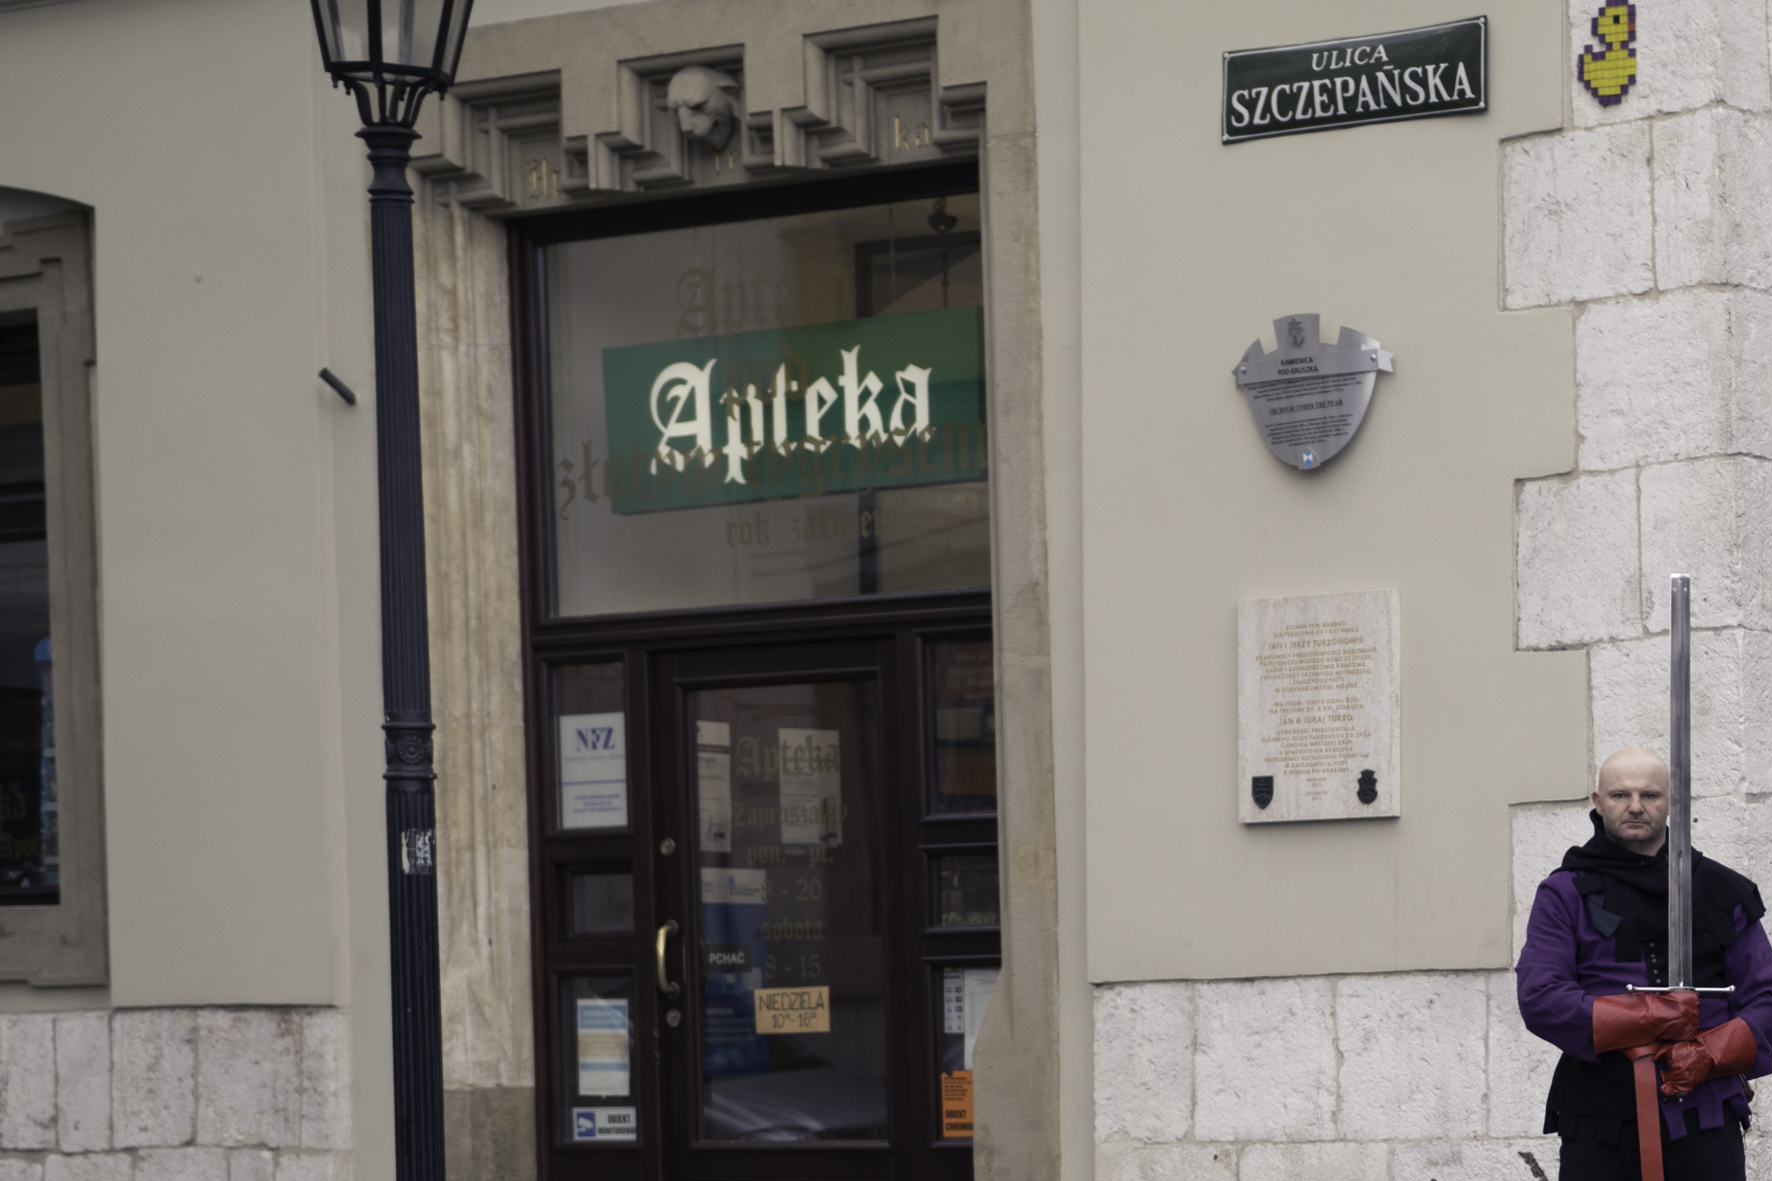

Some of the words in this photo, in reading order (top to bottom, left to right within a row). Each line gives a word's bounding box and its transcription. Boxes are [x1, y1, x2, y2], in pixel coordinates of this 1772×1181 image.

[1311, 44, 1390, 71] ULICA
[649, 344, 937, 485] Apteka
[576, 727, 615, 751] NFZ
[736, 735, 840, 782] Apteka
[796, 877, 823, 902] 20
[761, 915, 824, 940] sobota
[709, 950, 745, 965] PCHAĆ
[800, 953, 821, 978] 15
[758, 990, 824, 1011] NIEDZIELA
[607, 1113, 631, 1124] OBIEKT
